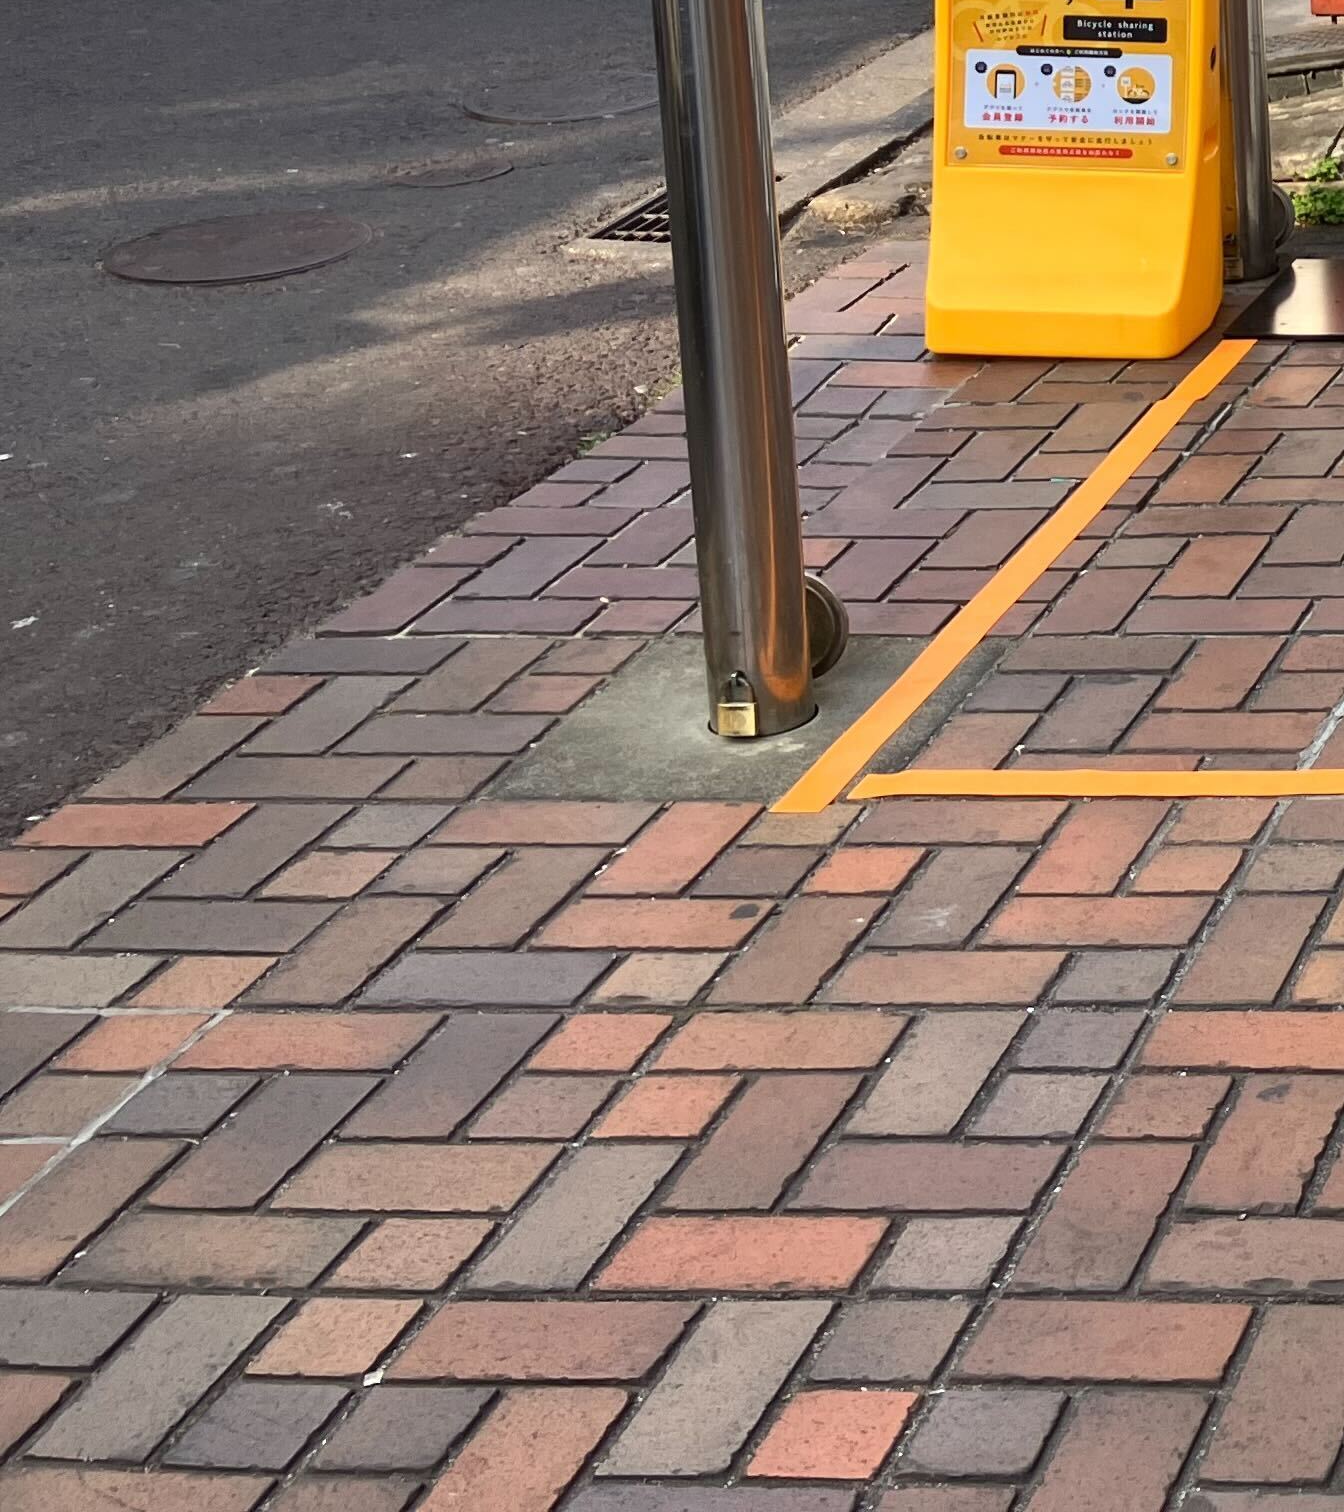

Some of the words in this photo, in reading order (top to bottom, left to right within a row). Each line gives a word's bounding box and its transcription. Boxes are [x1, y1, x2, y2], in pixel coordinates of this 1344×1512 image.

[1077, 19, 1112, 30] Bicycle
[1117, 21, 1154, 32] sharing
[1097, 30, 1133, 39] station
